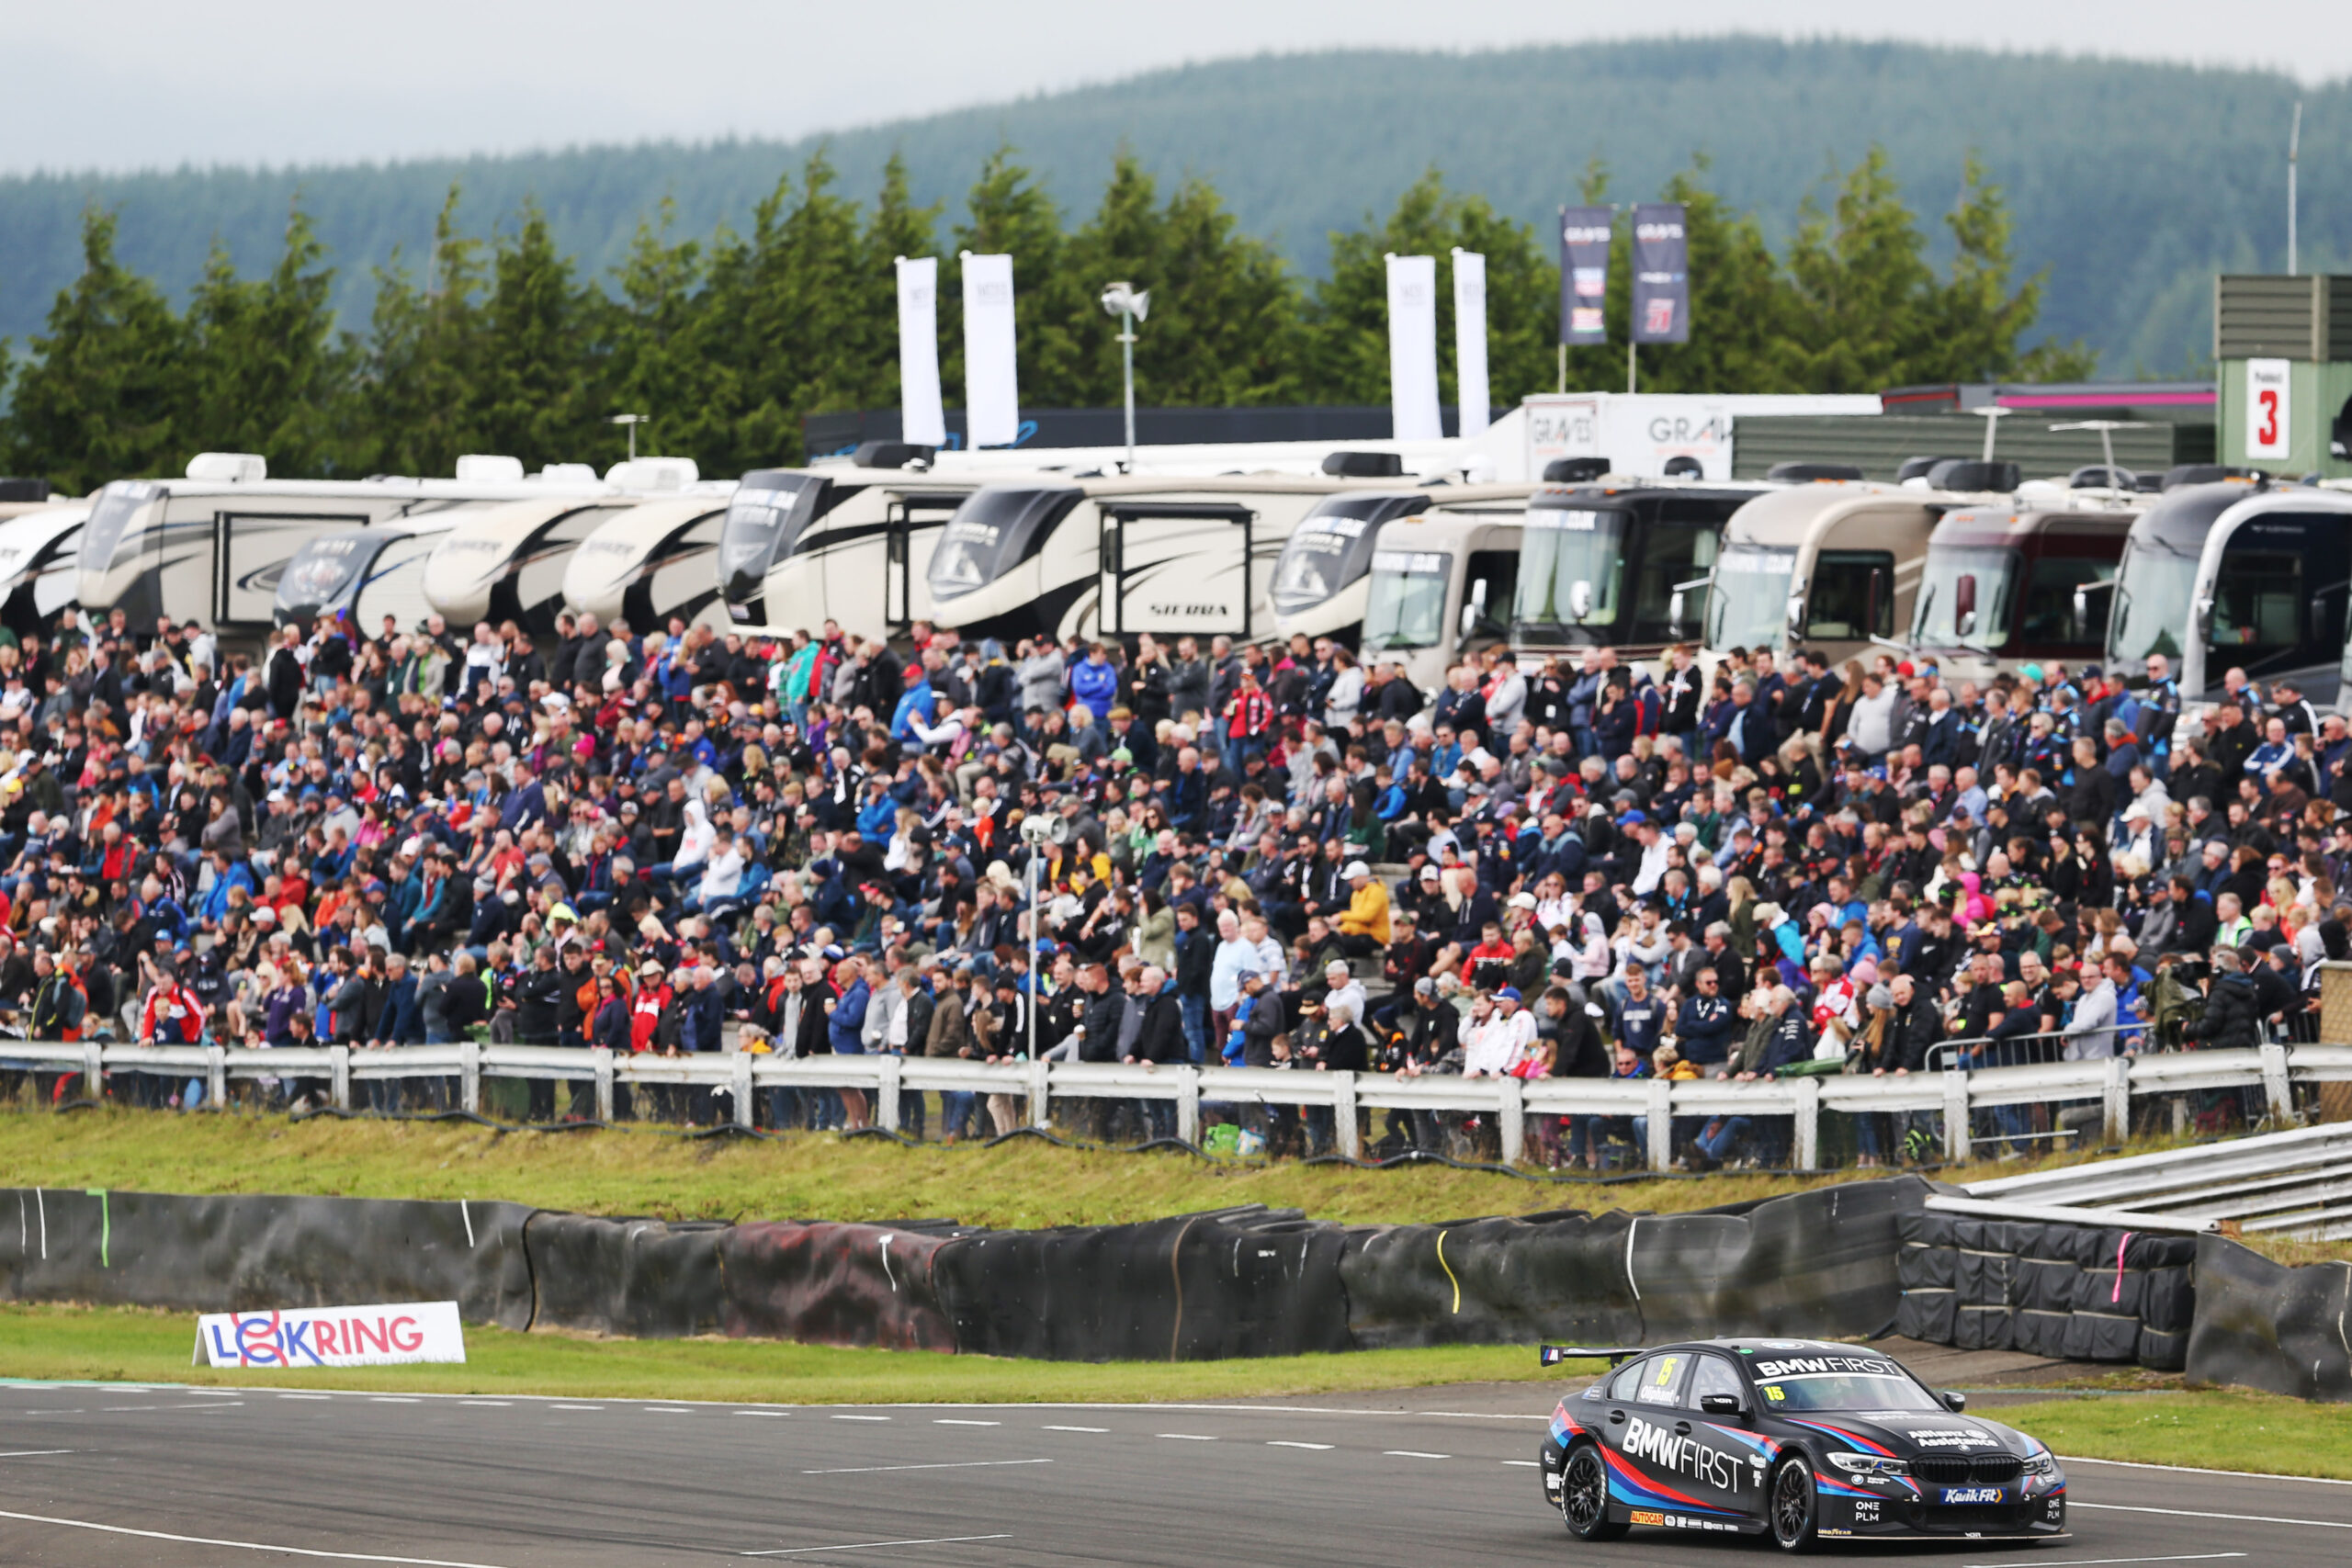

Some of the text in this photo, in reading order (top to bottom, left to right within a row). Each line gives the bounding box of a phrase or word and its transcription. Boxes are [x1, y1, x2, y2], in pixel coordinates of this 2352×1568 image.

[2259, 389, 2277, 445] 3
[1150, 604, 1227, 615] SIERRA
[1656, 1358, 1678, 1386] 15
[1641, 1384, 1675, 1403] Oliphant
[1764, 1385, 1786, 1401] 15
[1907, 1430, 1966, 1438] Allianz
[1917, 1438, 1998, 1448] Assistance
[1855, 1501, 1880, 1511] ONE
[2048, 1498, 2060, 1508] ONE
[1631, 1511, 1664, 1526] AUTOCAR
[1855, 1511, 1880, 1522] PLM
[2047, 1510, 2060, 1519] PLM
